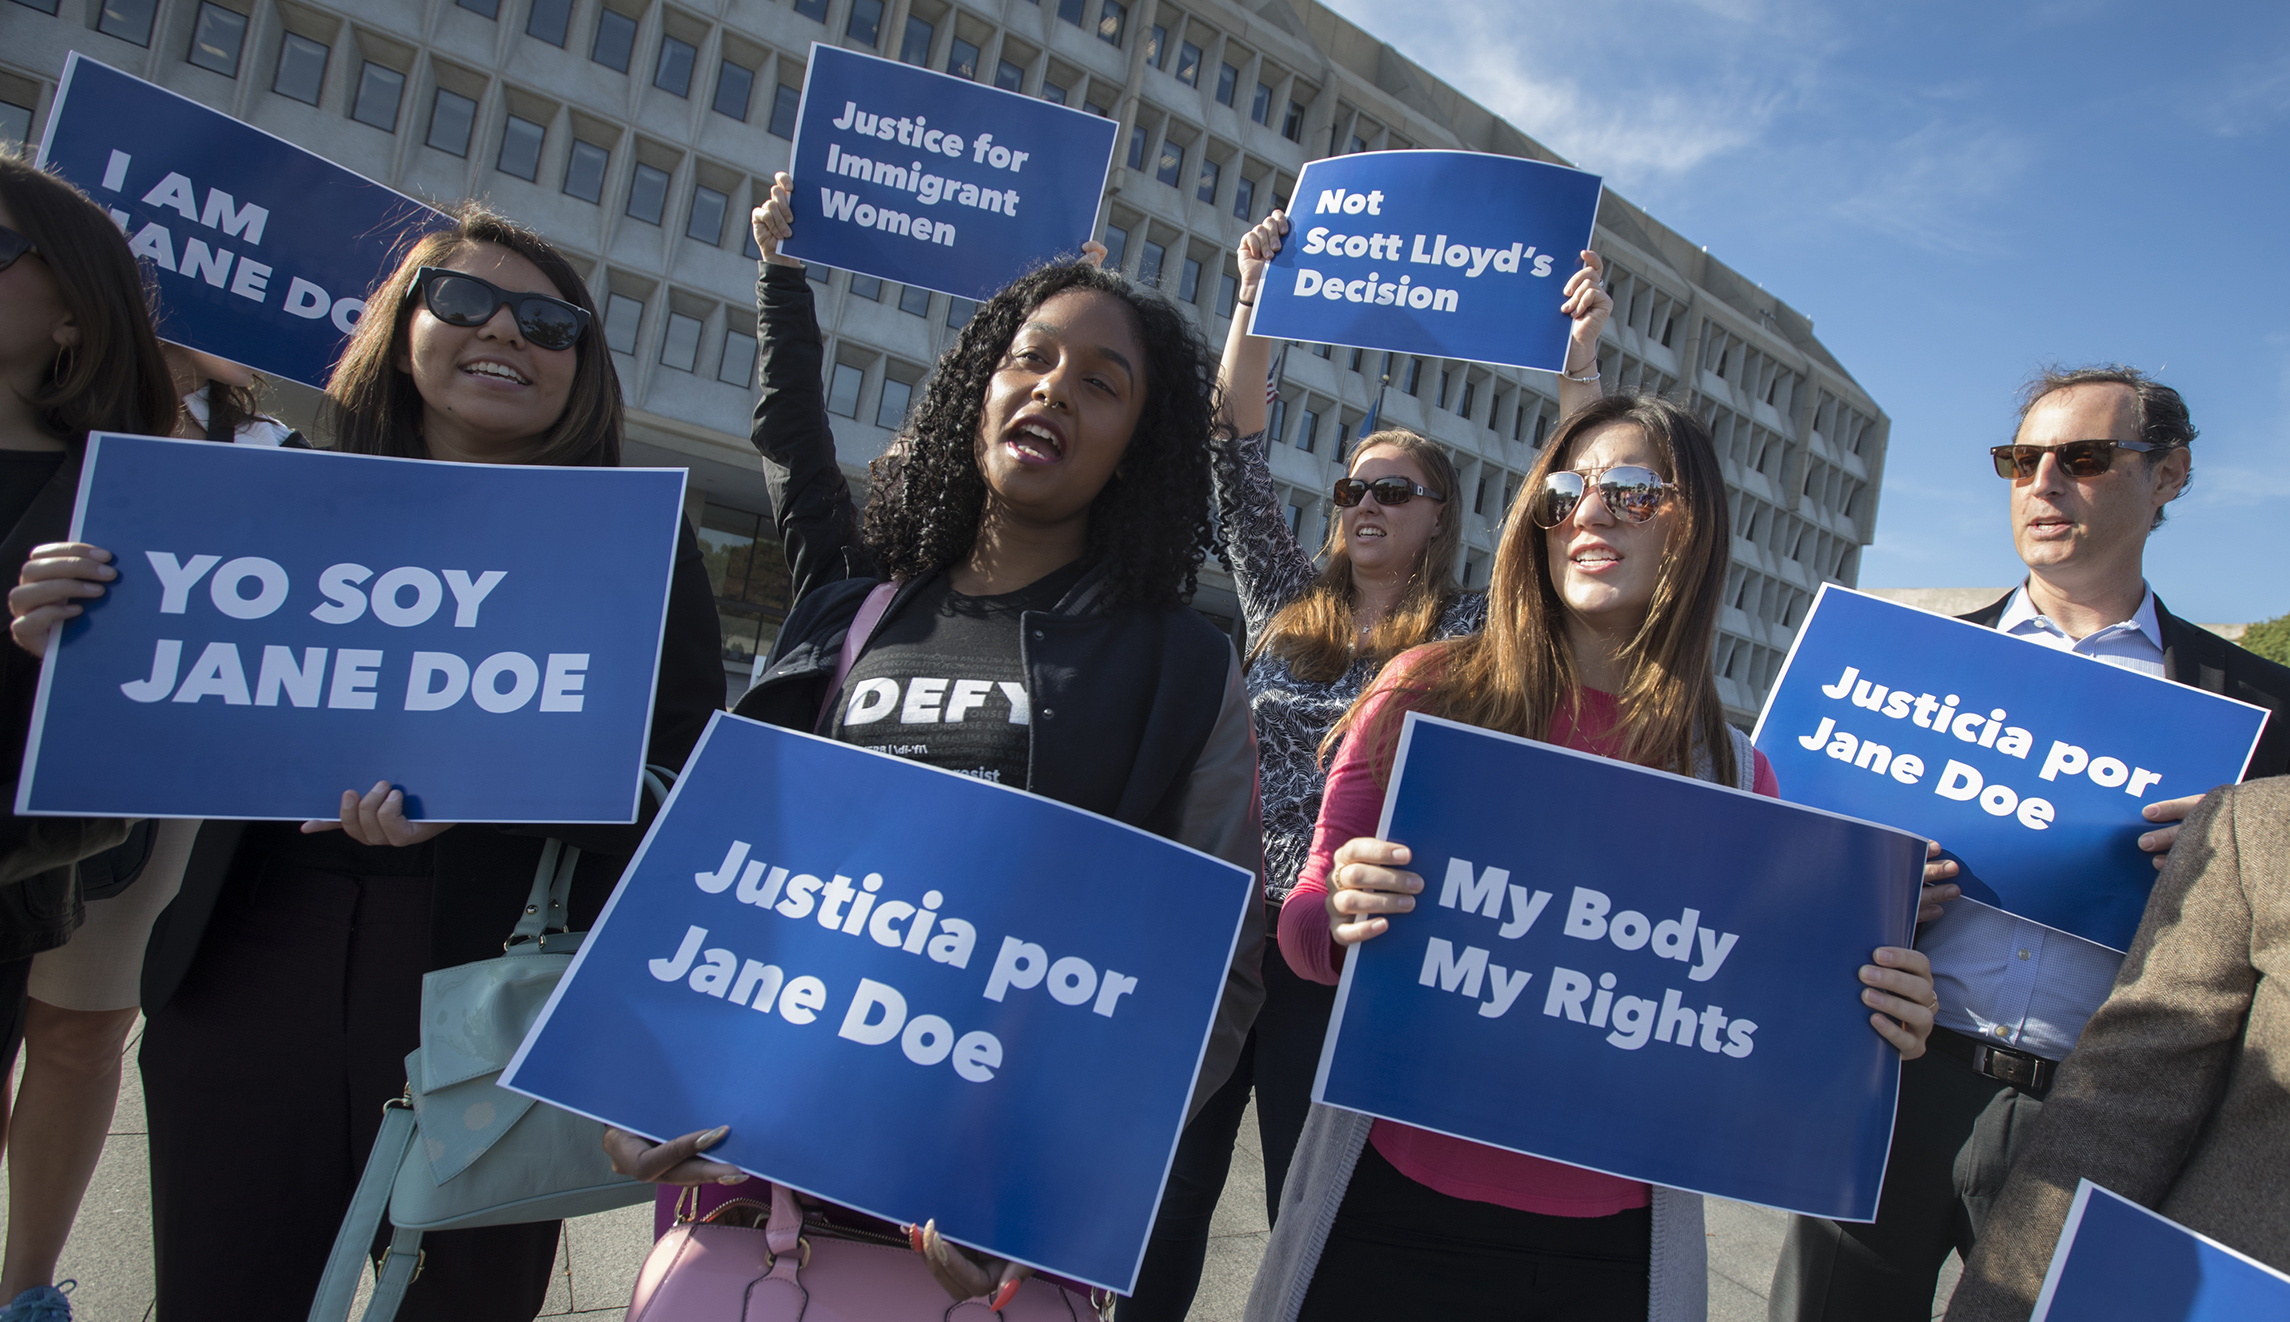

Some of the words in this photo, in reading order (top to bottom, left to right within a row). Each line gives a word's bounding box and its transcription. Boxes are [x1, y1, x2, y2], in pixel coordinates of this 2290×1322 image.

[832, 100, 964, 158] Justice
[972, 132, 1030, 173] for
[101, 148, 132, 193] I
[141, 171, 270, 246] AM
[820, 186, 956, 247] Women
[825, 143, 1020, 217] Immigrant
[1314, 188, 1385, 216] Not
[1301, 226, 1404, 262] Scott
[1409, 233, 1555, 278] Lloyd's
[282, 275, 370, 336] DO
[1293, 268, 1459, 313] Decision
[144, 550, 289, 620] YO
[309, 562, 508, 628] SOY
[120, 639, 384, 710] JANE
[403, 651, 590, 714] DOE
[843, 677, 1030, 727] DEFY
[1821, 665, 2034, 760] Justicia
[2038, 739, 2163, 798] por
[1798, 716, 1925, 785] Jane
[1934, 758, 2056, 831] Doe
[694, 839, 977, 970] Justicia
[982, 935, 1138, 1018] por
[1438, 856, 1554, 940] My
[1563, 885, 1740, 982] Body
[648, 924, 827, 1026] Jane
[837, 977, 1003, 1083] Doe
[1418, 936, 1533, 1019] My
[1543, 966, 1759, 1059] Rights
